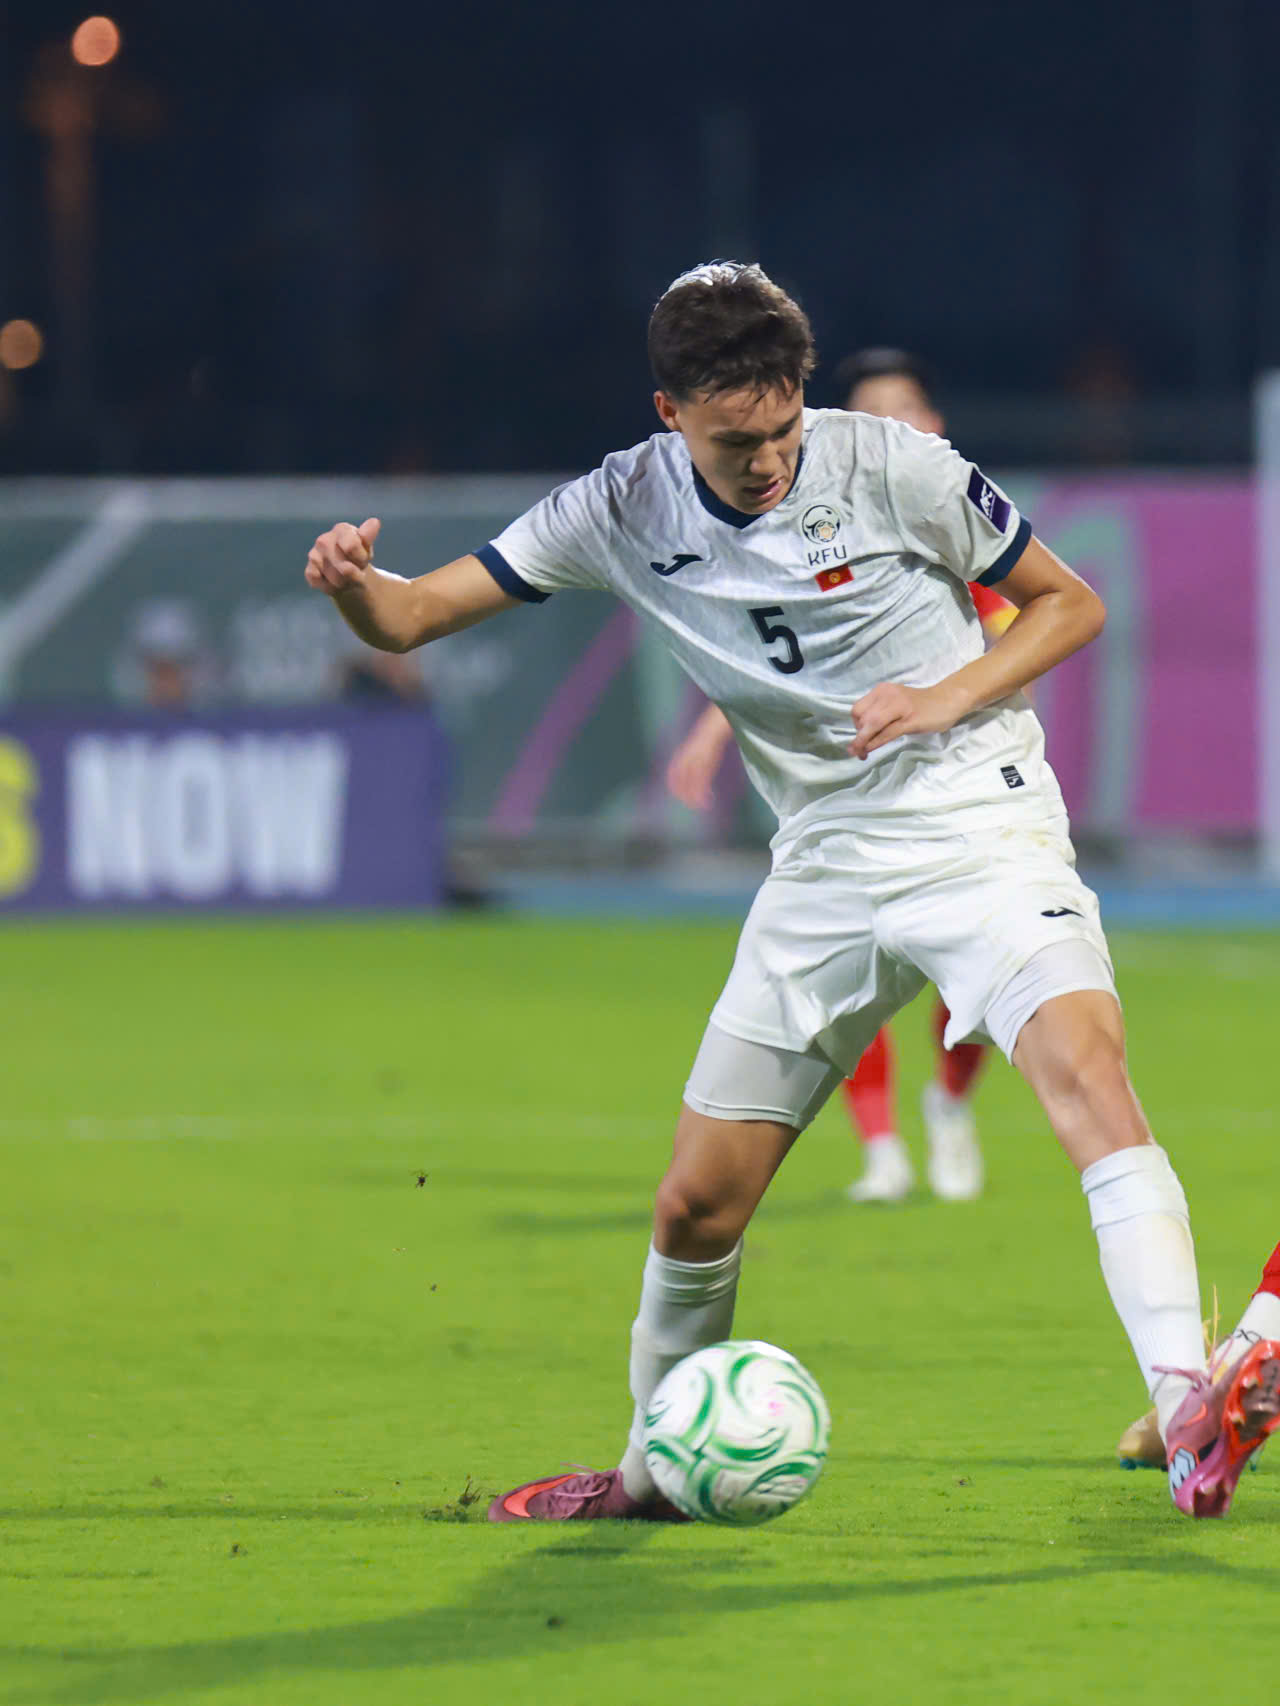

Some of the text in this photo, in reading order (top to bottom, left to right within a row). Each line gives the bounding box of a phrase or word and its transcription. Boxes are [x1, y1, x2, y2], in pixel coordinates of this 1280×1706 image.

[808, 545, 848, 567] KFU
[747, 605, 804, 674] 5
[69, 731, 348, 897] NOW
